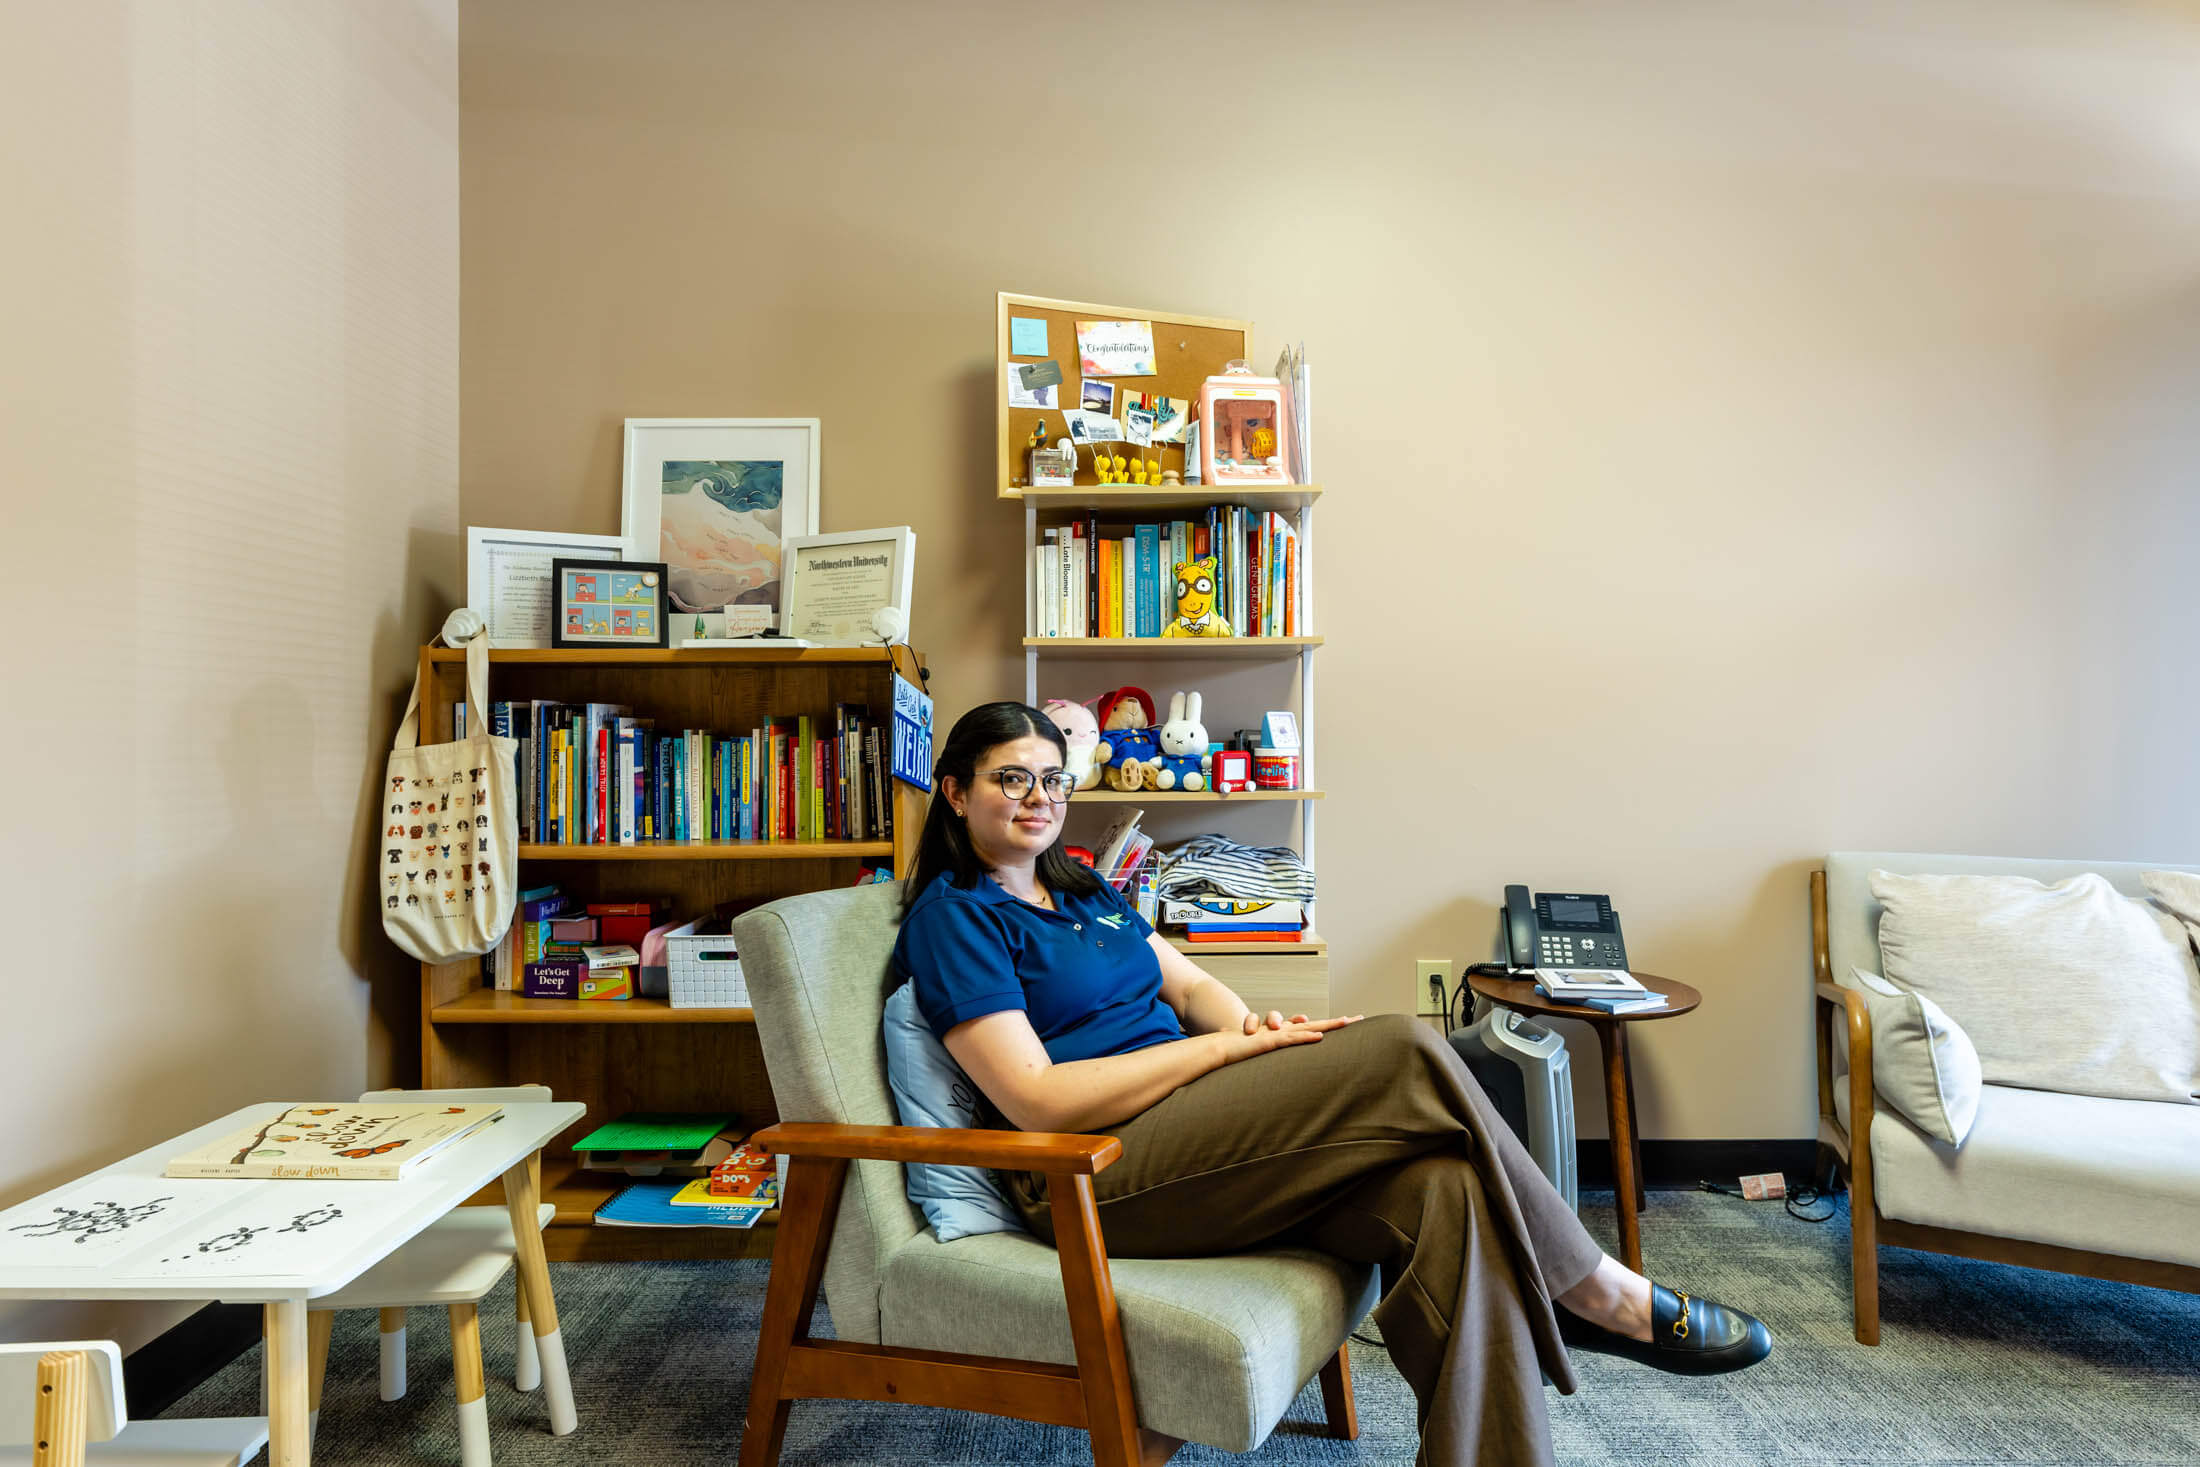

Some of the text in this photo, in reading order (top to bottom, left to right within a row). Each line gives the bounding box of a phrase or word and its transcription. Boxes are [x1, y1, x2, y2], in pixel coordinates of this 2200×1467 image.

[808, 555, 888, 571] Northwestern University
[1063, 546, 1071, 563] Late
[1063, 563, 1071, 597] Bloomers
[1250, 557, 1258, 620] GENOGRAMS
[895, 716, 932, 786] WEIRD
[1170, 910, 1203, 920] TROUBLE
[534, 967, 570, 976] Let's Get
[539, 976, 565, 991] Deep
[304, 1115, 364, 1142] slow
[322, 1115, 400, 1149] down
[271, 1165, 340, 1178] slow down
